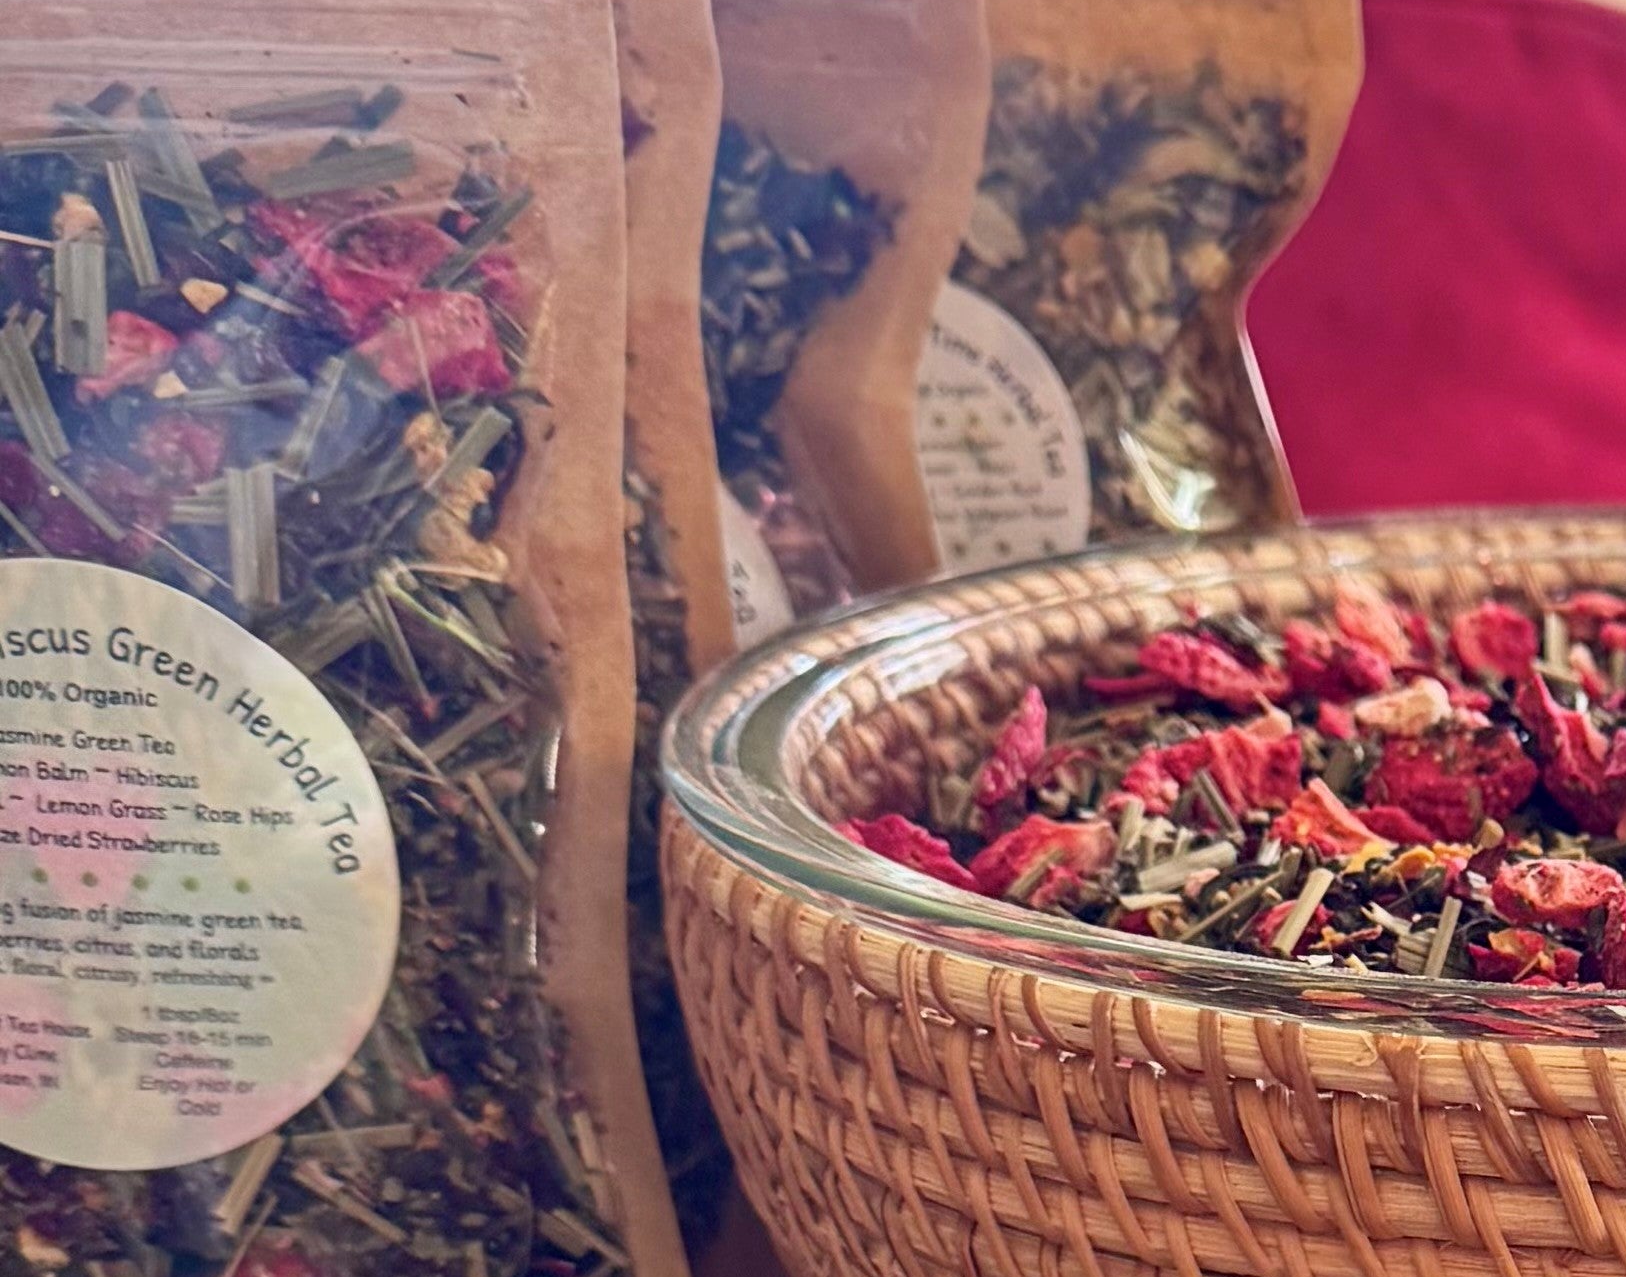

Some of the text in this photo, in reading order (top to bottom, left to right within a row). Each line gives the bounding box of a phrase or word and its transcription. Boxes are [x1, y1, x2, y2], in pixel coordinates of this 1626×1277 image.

[63, 681, 159, 709] Organic
[71, 729, 133, 753] Green
[137, 732, 177, 756] Tea
[107, 626, 220, 702] Green
[227, 687, 339, 802] Herbal
[319, 802, 361, 875] Tea
[36, 760, 89, 784] Balm
[116, 766, 201, 791] Hibiscus
[35, 792, 104, 818] Lemon
[109, 797, 168, 821] Grass
[194, 802, 244, 825] Rose
[28, 824, 82, 850] Dried
[86, 828, 222, 857] Strawberries
[86, 902, 108, 924] of
[200, 913, 262, 938] green
